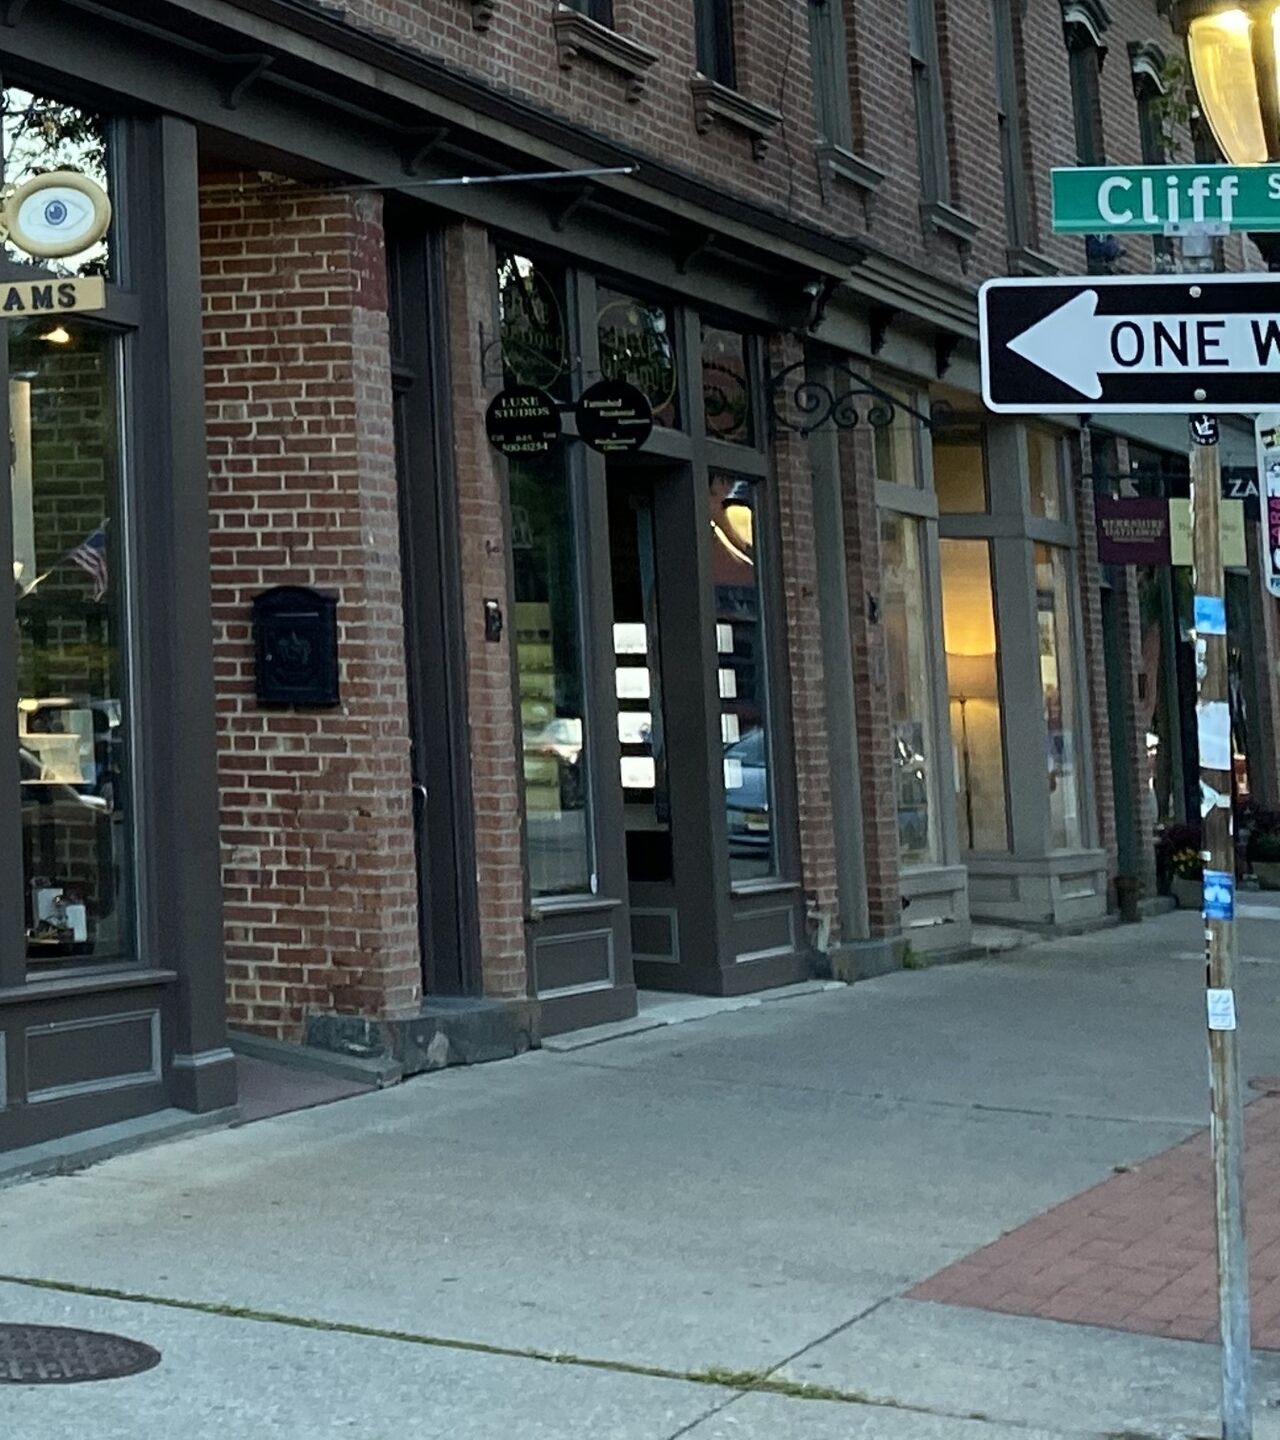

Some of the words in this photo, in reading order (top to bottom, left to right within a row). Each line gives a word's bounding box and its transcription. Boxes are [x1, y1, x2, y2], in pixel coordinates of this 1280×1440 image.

[1097, 174, 1239, 224] Cliff
[1110, 320, 1229, 367] ONE
[494, 407, 550, 418] STUDIOS
[501, 396, 539, 408] LUXE
